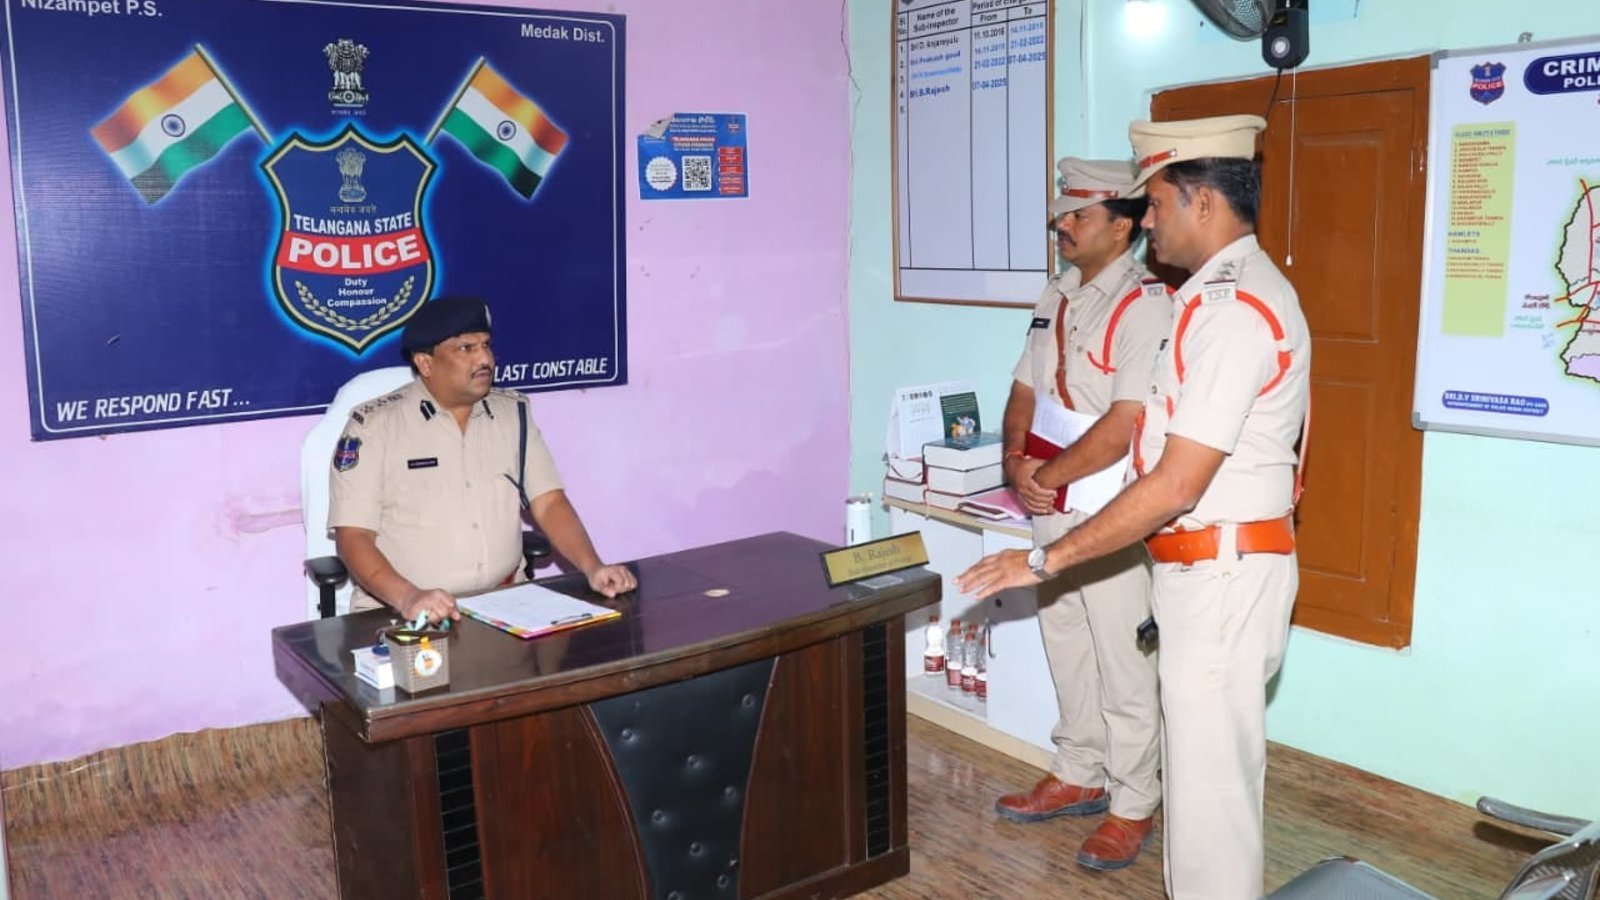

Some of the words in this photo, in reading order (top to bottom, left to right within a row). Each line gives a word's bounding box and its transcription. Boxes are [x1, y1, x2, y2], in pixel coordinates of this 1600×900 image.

[126, 0, 163, 17] P.S.
[1024, 7, 1032, 15] To
[980, 14, 998, 22] From
[521, 23, 569, 40] Medak
[573, 27, 606, 43] Dist.
[1471, 81, 1504, 90] POLICE
[293, 214, 371, 235] TELANGANA
[374, 212, 412, 233] STATE
[288, 234, 421, 269] POLICE
[344, 278, 368, 287] Duty
[338, 287, 375, 297] Honour
[327, 298, 387, 308] Compassion
[494, 364, 529, 382] LAST
[532, 357, 609, 379] CONSTABLE
[56, 401, 88, 422] WE
[94, 393, 181, 419] RESPOND
